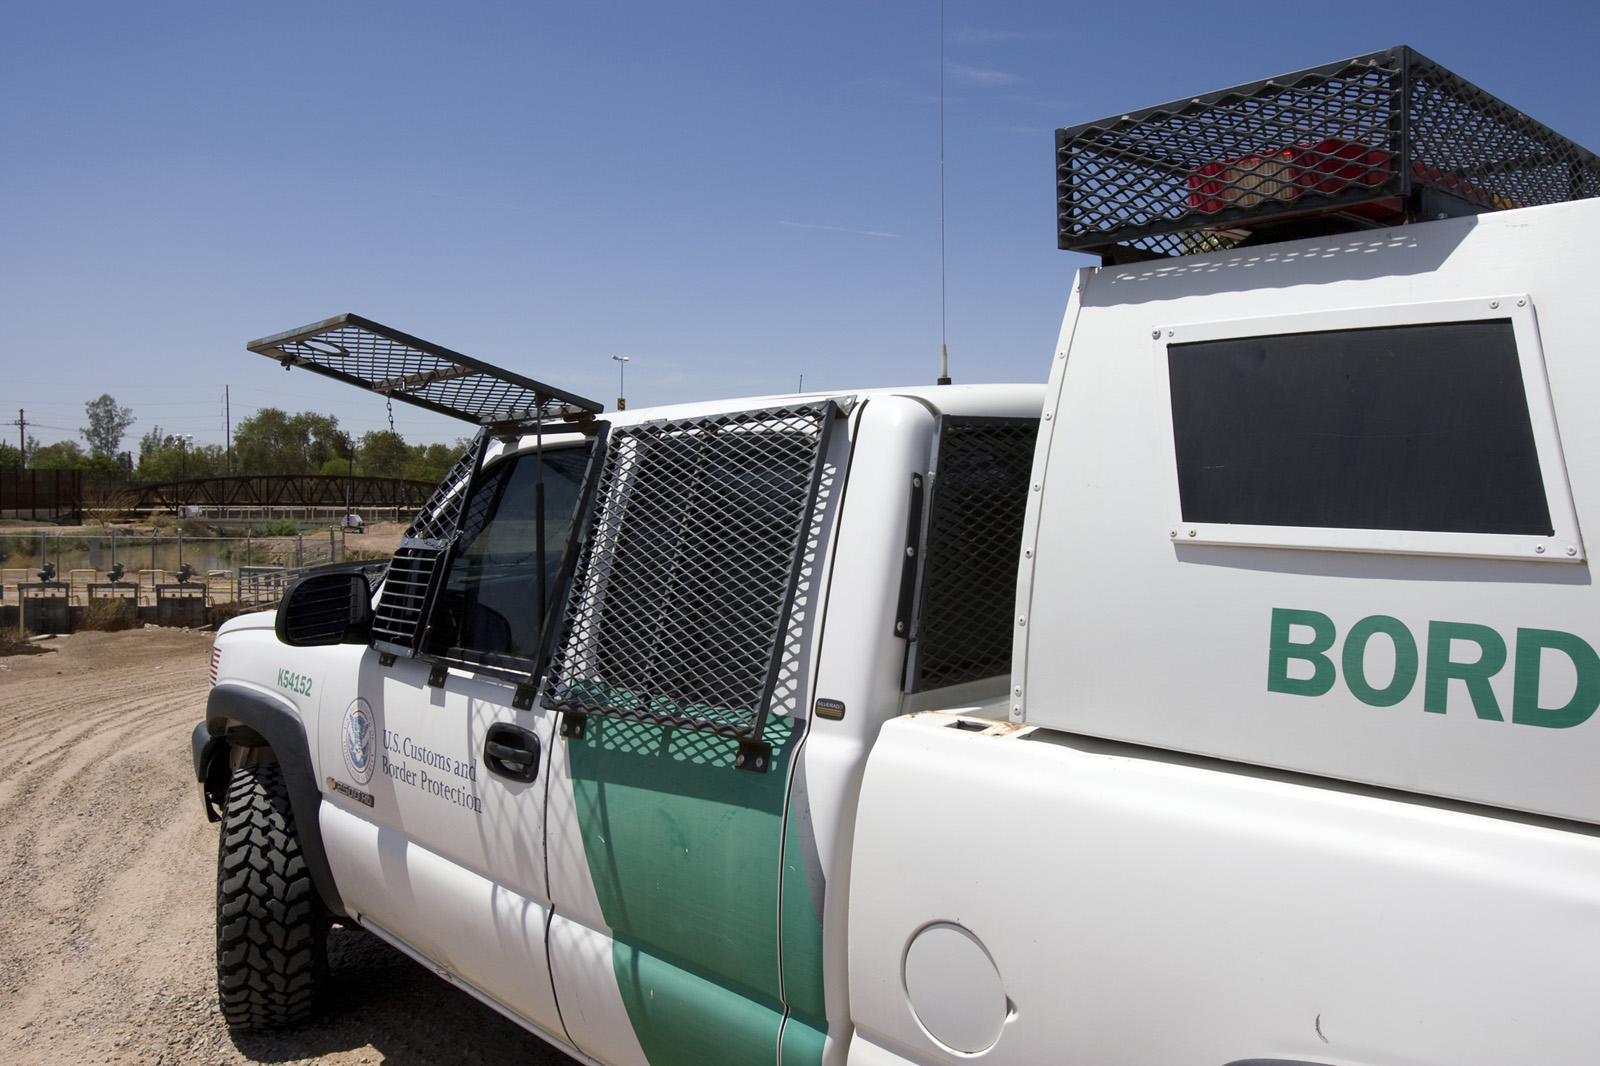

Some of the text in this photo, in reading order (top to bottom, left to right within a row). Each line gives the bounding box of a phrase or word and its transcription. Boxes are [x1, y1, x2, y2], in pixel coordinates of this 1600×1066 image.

[277, 667, 313, 697] K54152
[1267, 607, 1600, 729] BORD
[817, 700, 844, 710] SILVERADO
[383, 729, 477, 782] U.S. Customs and
[382, 754, 417, 786] Border
[420, 770, 483, 814] Protection
